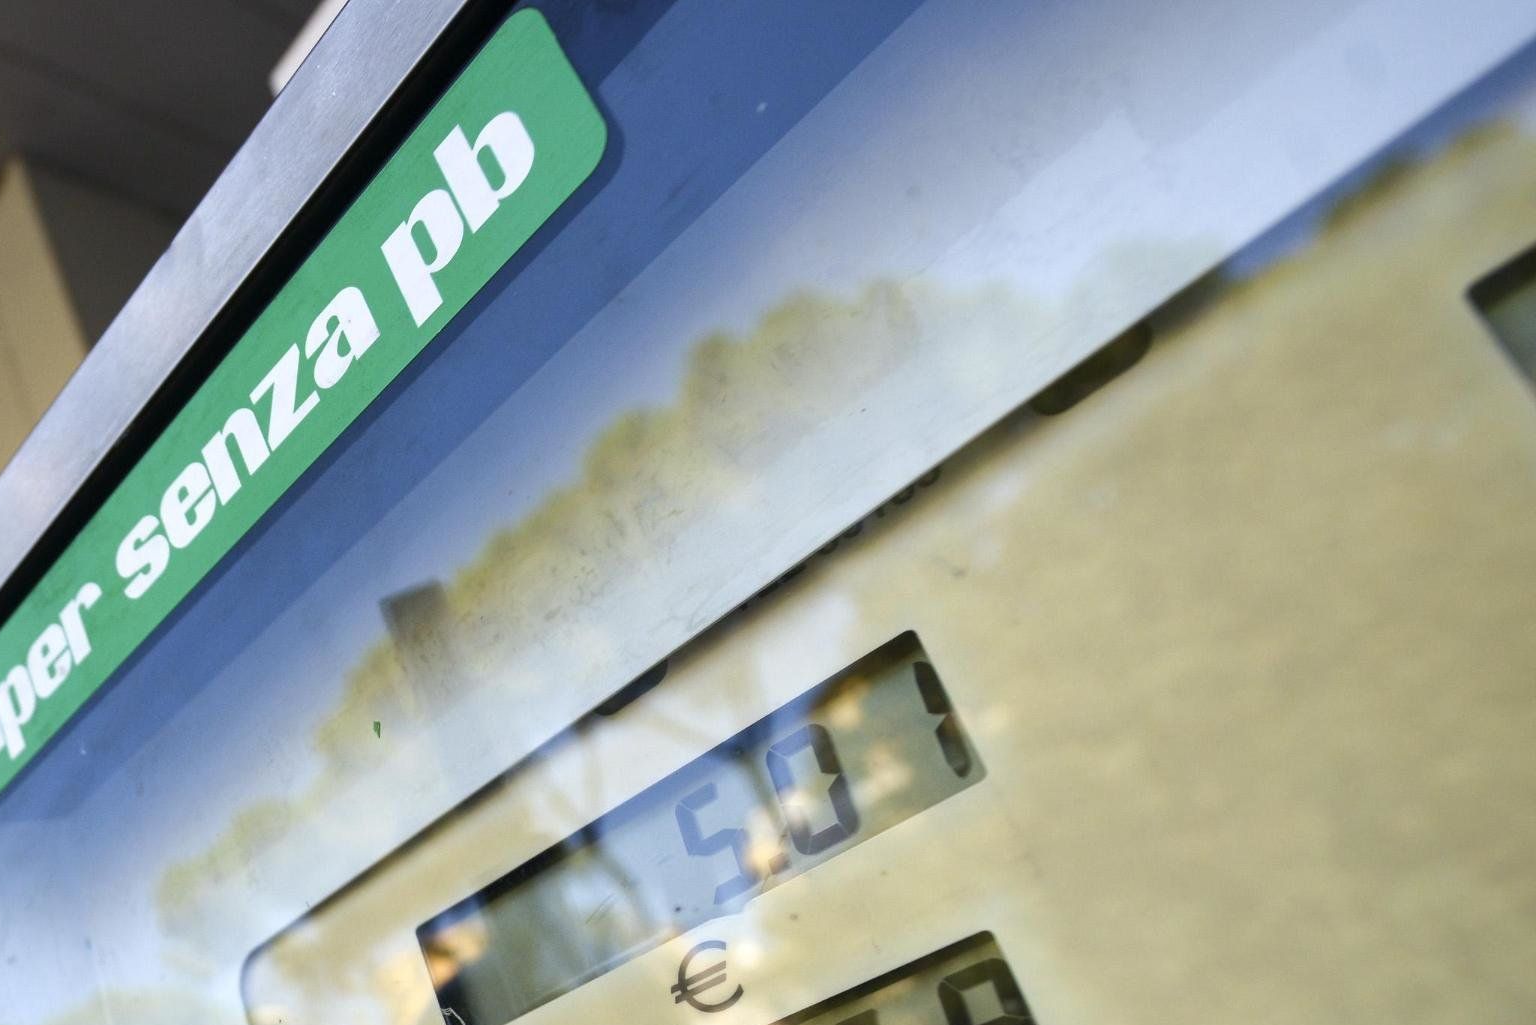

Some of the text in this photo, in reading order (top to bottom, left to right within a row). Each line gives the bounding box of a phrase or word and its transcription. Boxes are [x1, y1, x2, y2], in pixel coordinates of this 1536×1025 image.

[115, 286, 381, 600] senza
[381, 110, 535, 328] pb
[674, 661, 968, 906] 5.01
[670, 940, 744, 1013] €
